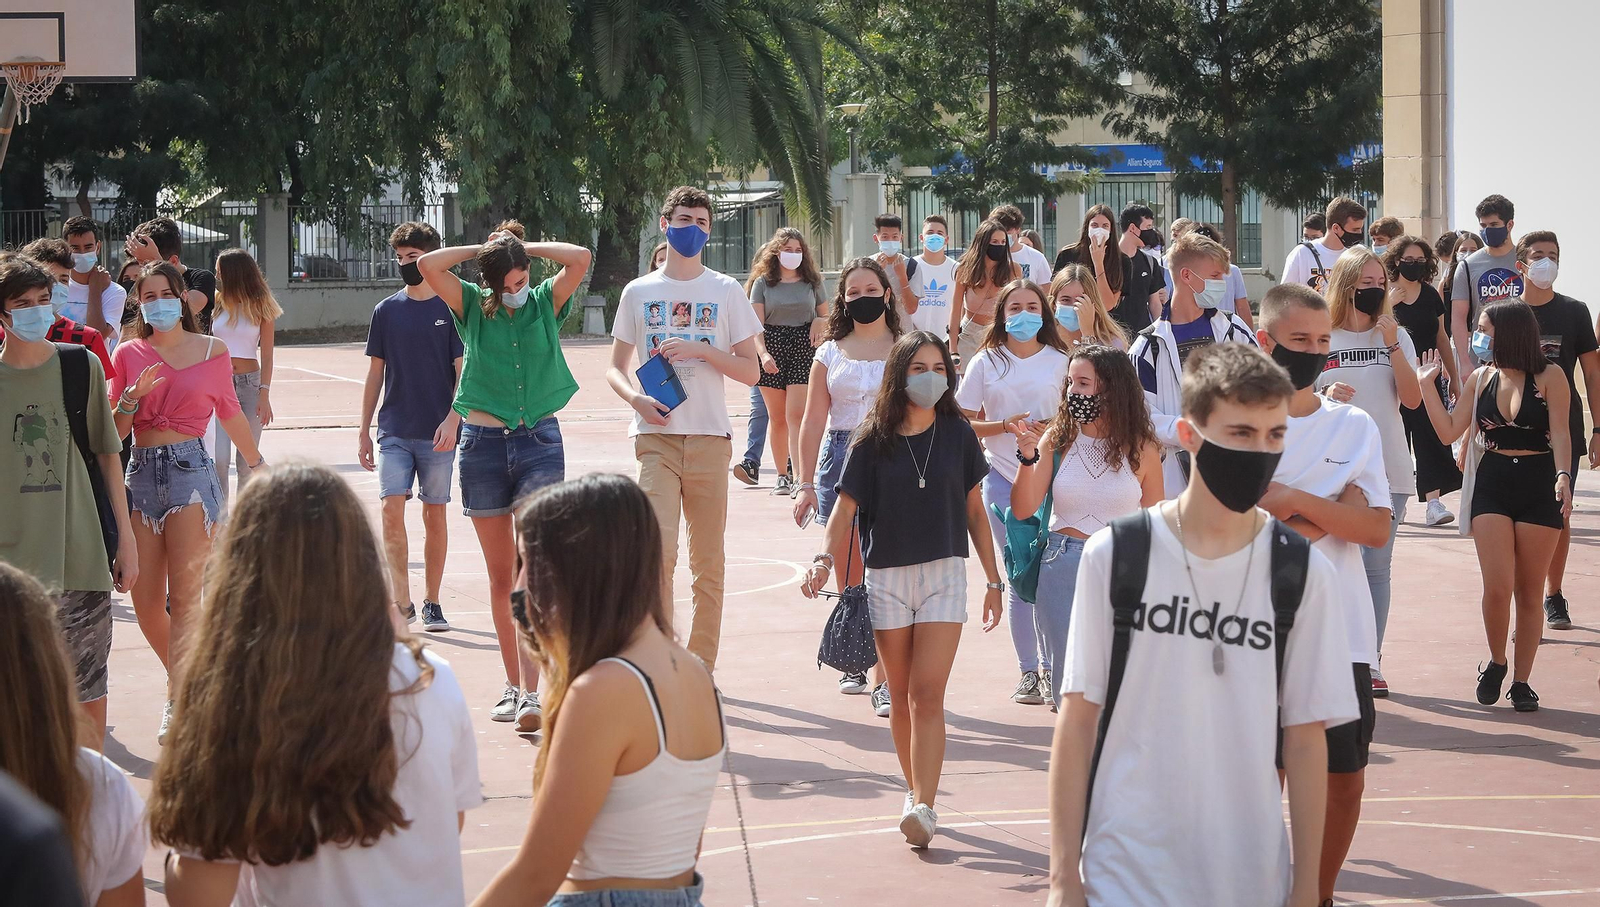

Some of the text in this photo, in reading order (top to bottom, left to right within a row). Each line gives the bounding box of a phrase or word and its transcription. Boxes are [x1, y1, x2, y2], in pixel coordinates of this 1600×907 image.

[1127, 158, 1162, 168] Allianz Seguros
[1481, 284, 1520, 298] BOWIE
[919, 299, 946, 307] adidas
[1341, 350, 1376, 362] PUMA
